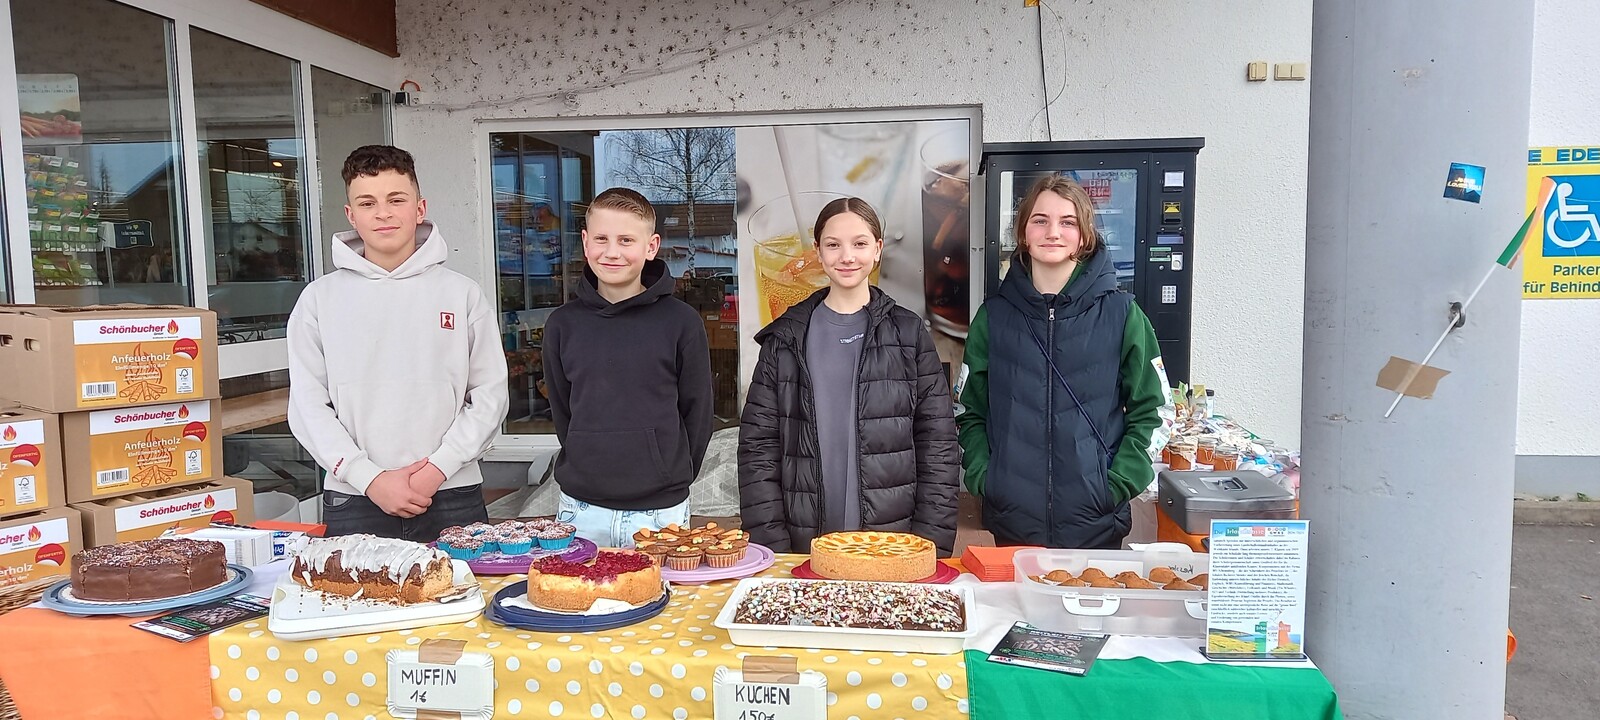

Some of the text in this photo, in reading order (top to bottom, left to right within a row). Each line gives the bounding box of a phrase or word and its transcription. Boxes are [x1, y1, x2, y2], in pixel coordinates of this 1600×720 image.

[1523, 281, 1546, 293] für
[99, 324, 166, 335] Schönbucher
[111, 352, 171, 364] Anfeuerholz
[114, 410, 177, 424] Schönbucher
[124, 436, 181, 451] Anfeuerholz
[139, 501, 202, 519] Schönbucher
[401, 668, 457, 686] MUFFIN
[735, 684, 791, 706] KUCHEN
